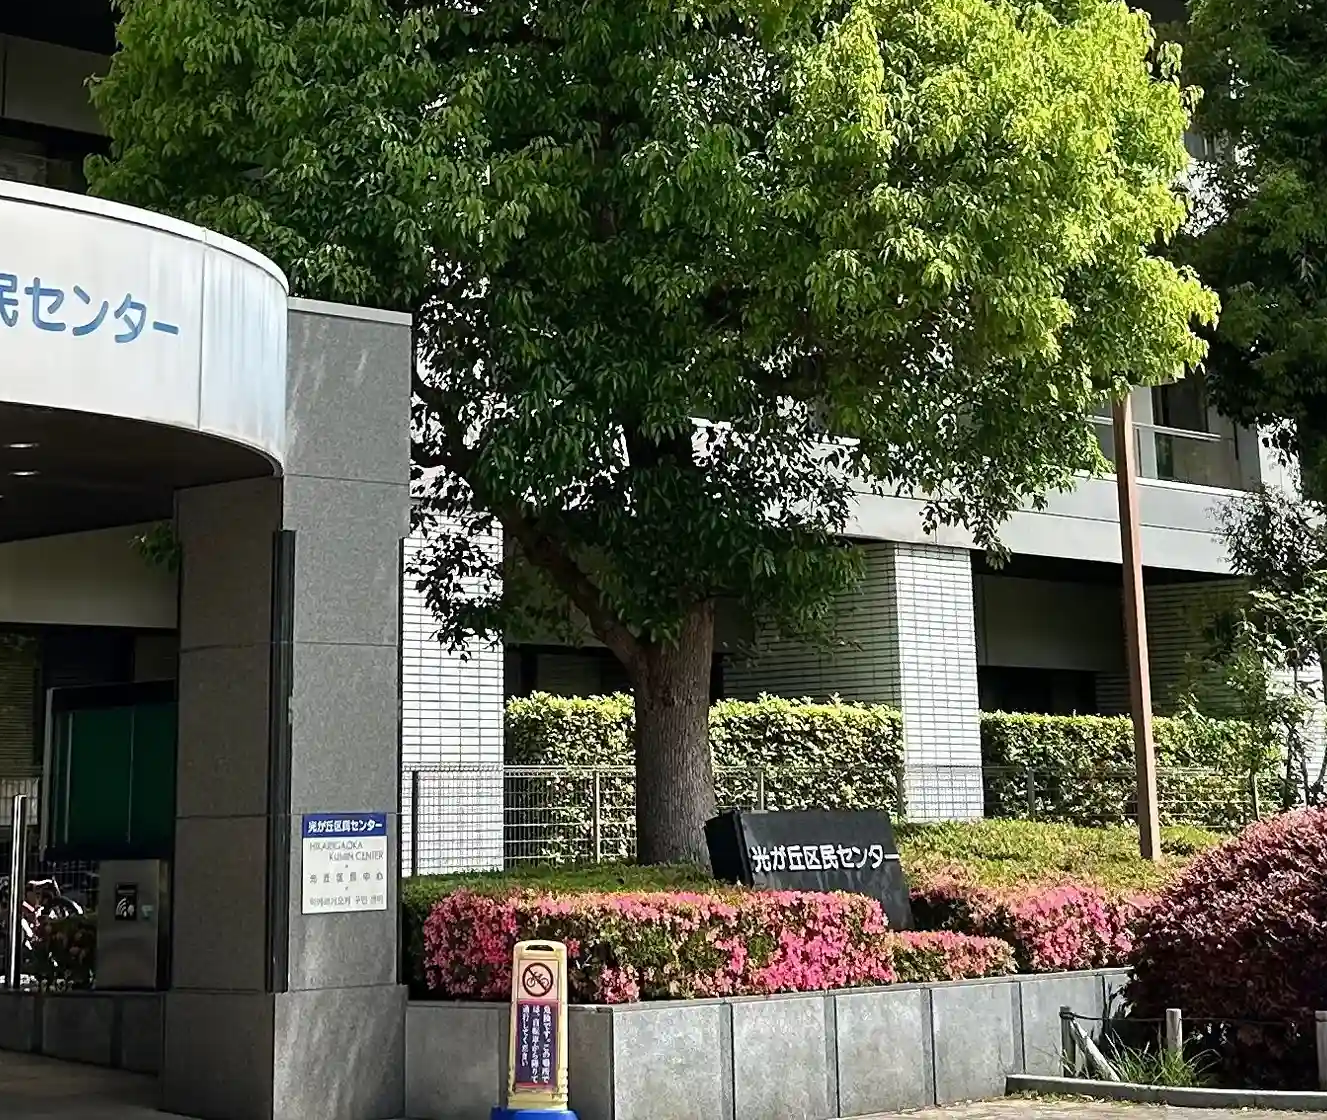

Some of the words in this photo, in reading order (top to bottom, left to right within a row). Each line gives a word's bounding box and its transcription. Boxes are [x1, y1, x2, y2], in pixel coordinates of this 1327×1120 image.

[307, 819, 383, 834] 光が丘区民センター
[355, 851, 384, 861] CENTER
[750, 843, 901, 874] 光が丘区民センター
